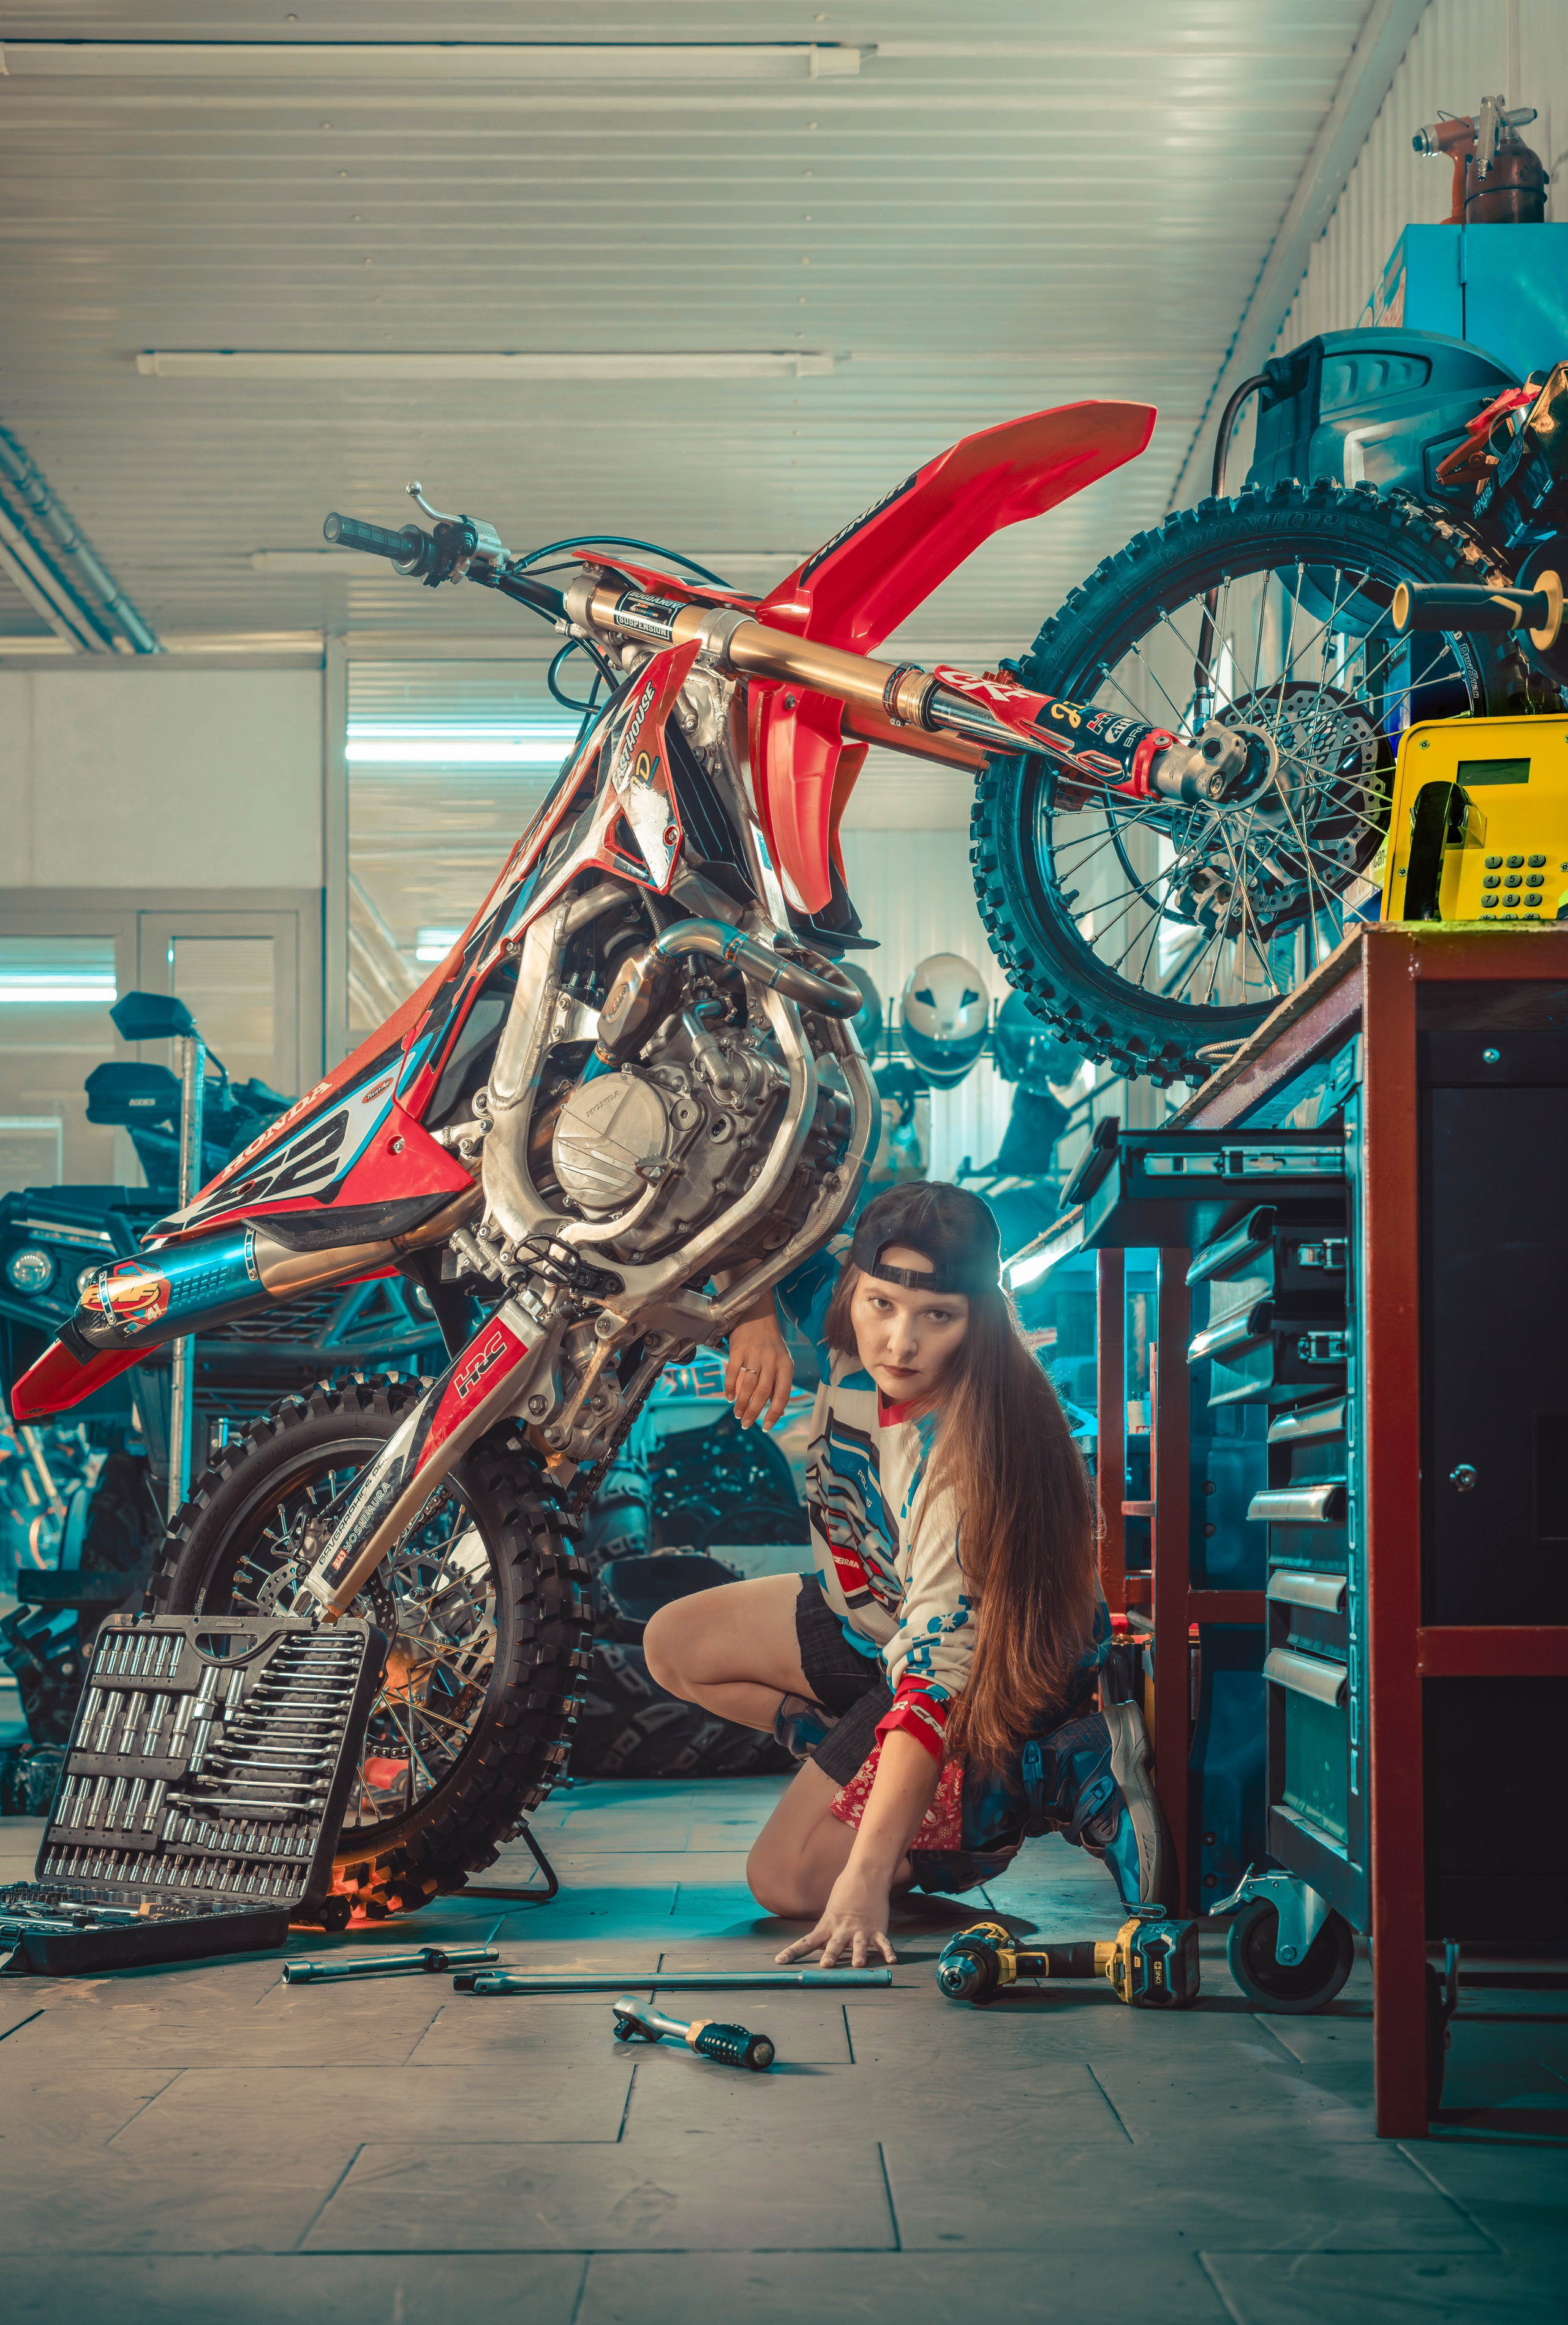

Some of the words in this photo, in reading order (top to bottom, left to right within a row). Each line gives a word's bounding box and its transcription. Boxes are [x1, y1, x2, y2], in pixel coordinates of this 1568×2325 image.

[1186, 511, 1340, 550] DUNLOP
[629, 591, 685, 608] BOGDANOV
[619, 616, 667, 636] SUSPENSION
[586, 1090, 621, 1118] HONDA
[222, 1081, 333, 1179] HONDA
[80, 1282, 159, 1305] FMF
[453, 1330, 507, 1400] HRC
[342, 1482, 392, 1553] YOSHIMURA
